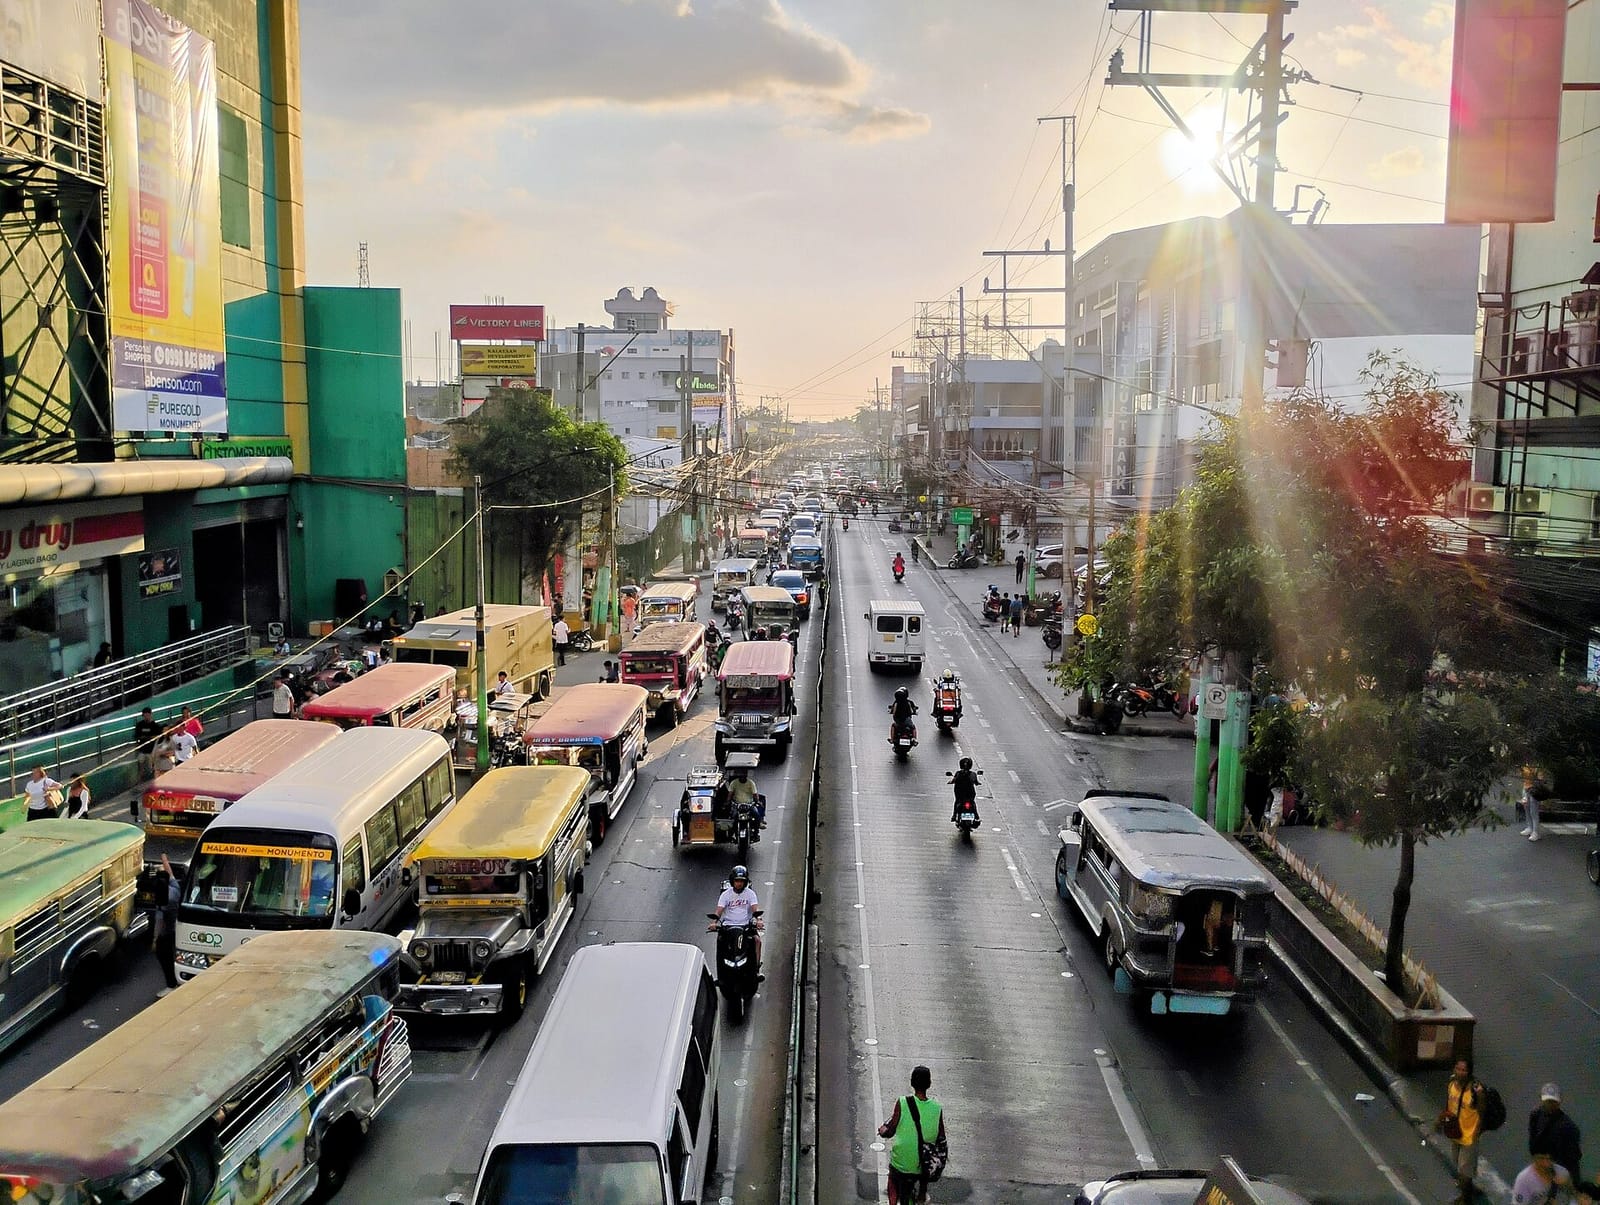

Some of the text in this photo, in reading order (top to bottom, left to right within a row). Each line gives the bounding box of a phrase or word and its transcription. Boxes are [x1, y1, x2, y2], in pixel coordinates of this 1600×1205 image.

[469, 318, 541, 328] VICTORY LINER
[124, 341, 152, 356] Personal
[124, 351, 152, 364] SHOPPER
[144, 371, 203, 393] abenson.com
[160, 402, 202, 417] PUREGOLD
[159, 419, 202, 431] MONUMENTO
[1116, 437, 1126, 490] BANK
[19, 519, 72, 551] drug
[6, 557, 36, 569] LAGING
[36, 553, 58, 563] BAGO
[206, 845, 248, 854] MALABON
[266, 848, 325, 859] MONUMENTO
